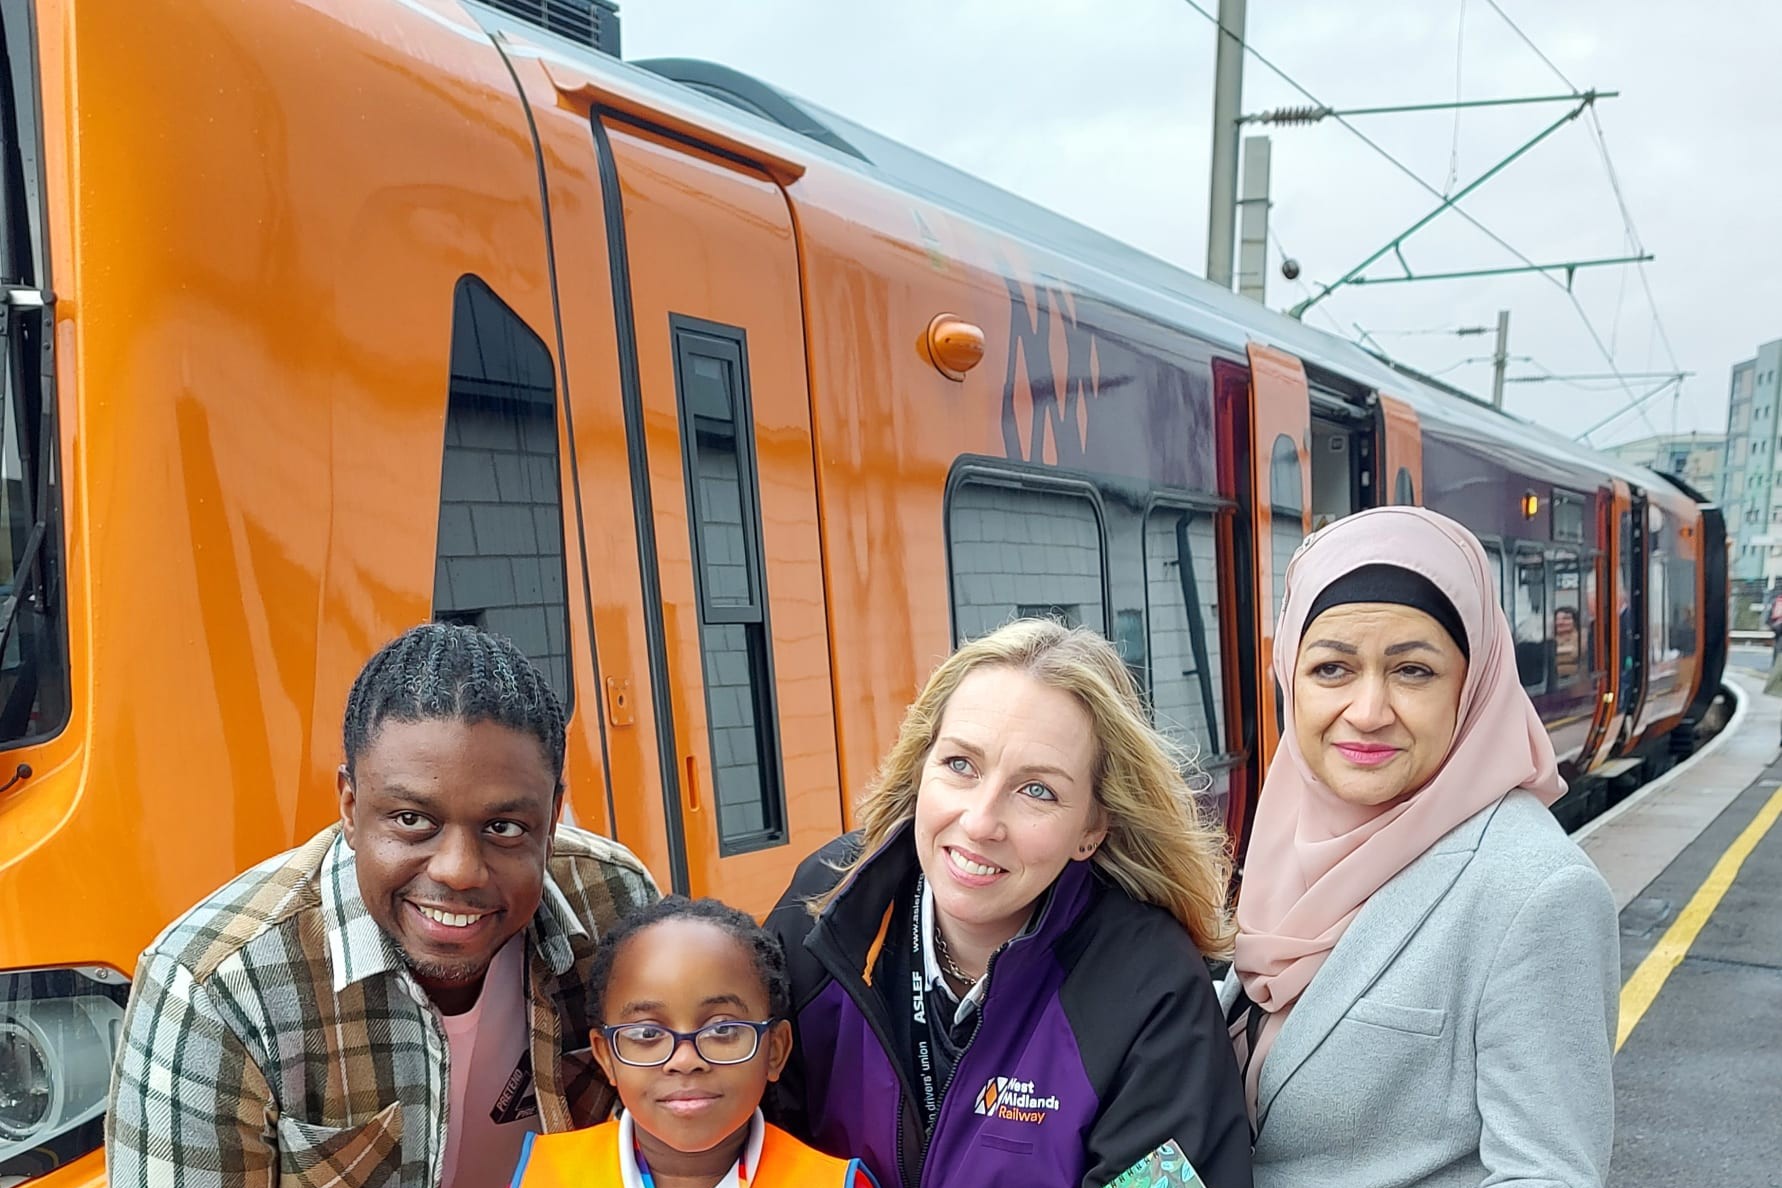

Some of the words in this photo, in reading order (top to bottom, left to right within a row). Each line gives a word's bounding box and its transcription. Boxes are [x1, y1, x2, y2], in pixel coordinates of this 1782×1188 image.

[911, 971, 926, 1024] ASLEF
[918, 1041, 930, 1071] union
[496, 1068, 523, 1112] PRETEND
[1007, 1077, 1035, 1094] West
[1002, 1091, 1060, 1110] Midlands
[998, 1105, 1046, 1124] Railway
